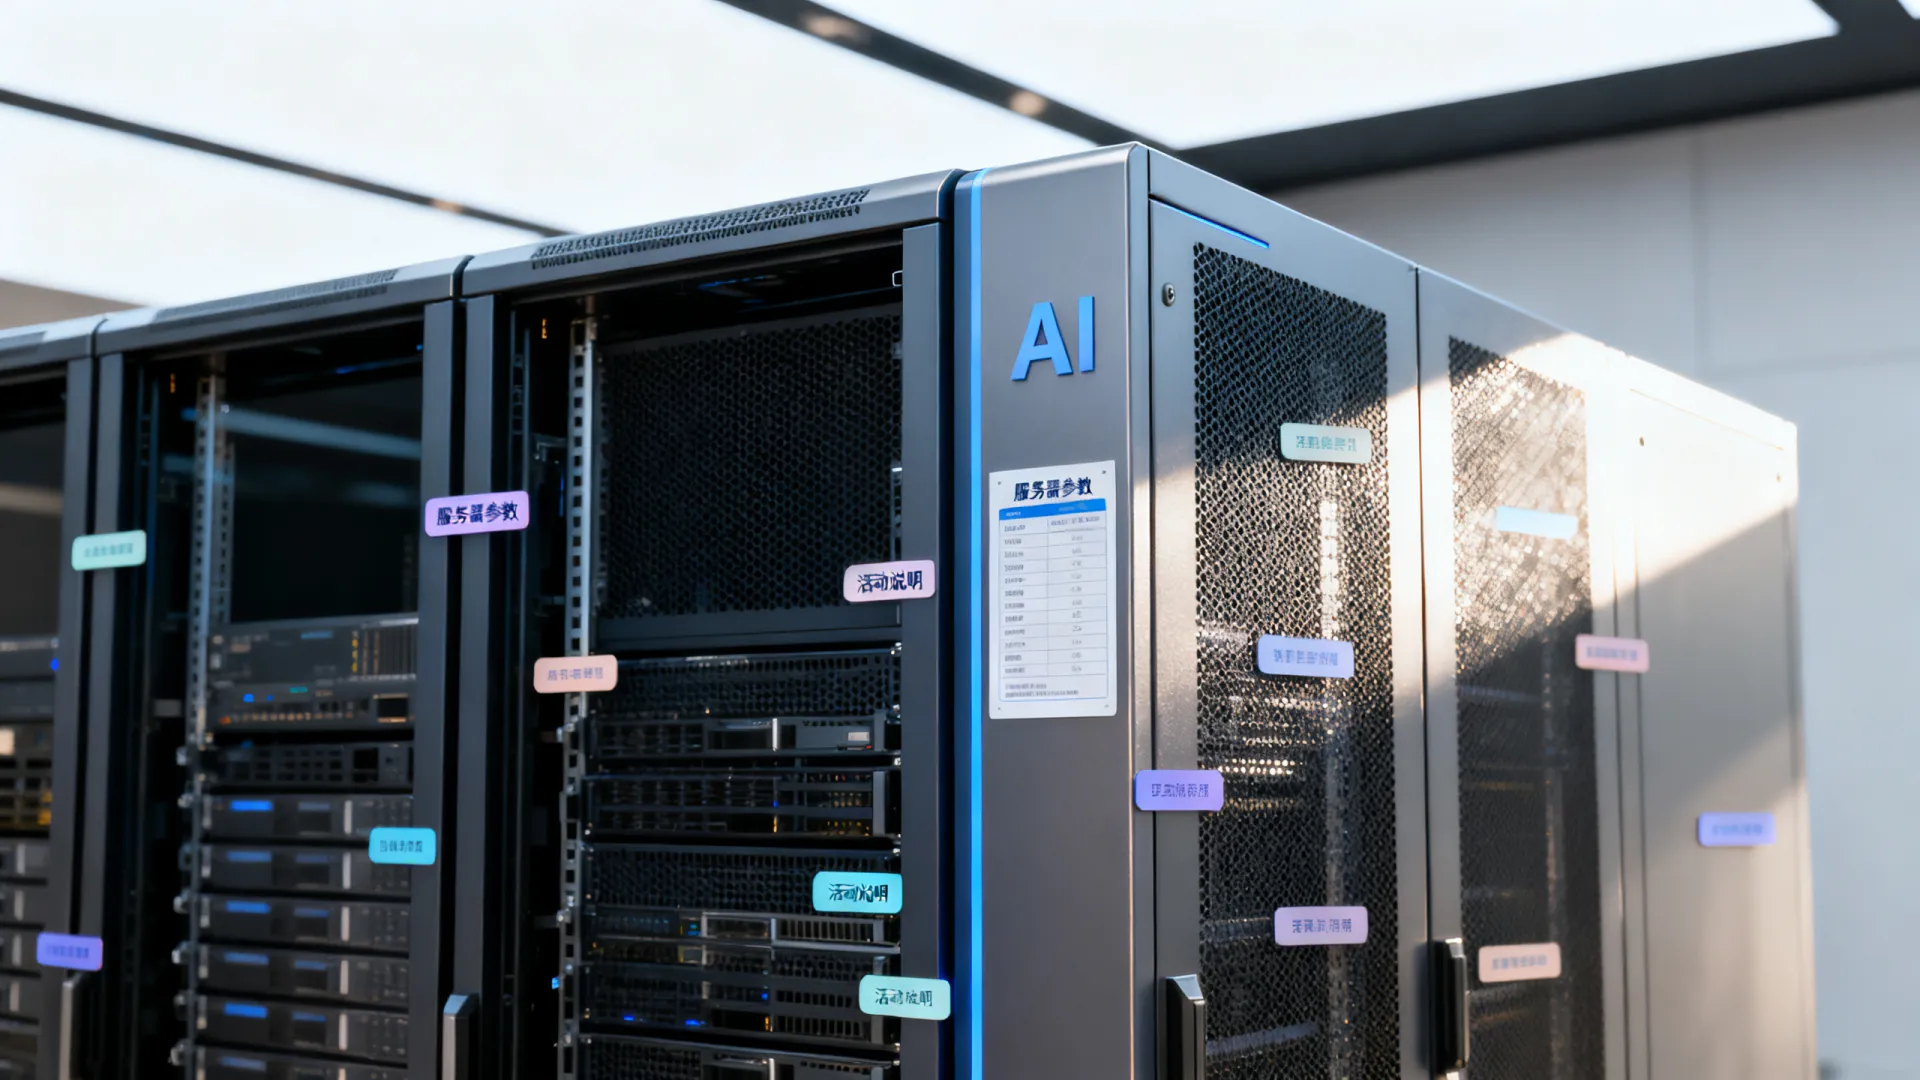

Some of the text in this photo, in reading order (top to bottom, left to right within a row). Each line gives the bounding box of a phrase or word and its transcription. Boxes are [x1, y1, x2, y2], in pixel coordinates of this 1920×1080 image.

[1011, 295, 1095, 381] AI
[1013, 476, 1093, 502] 服务器参数
